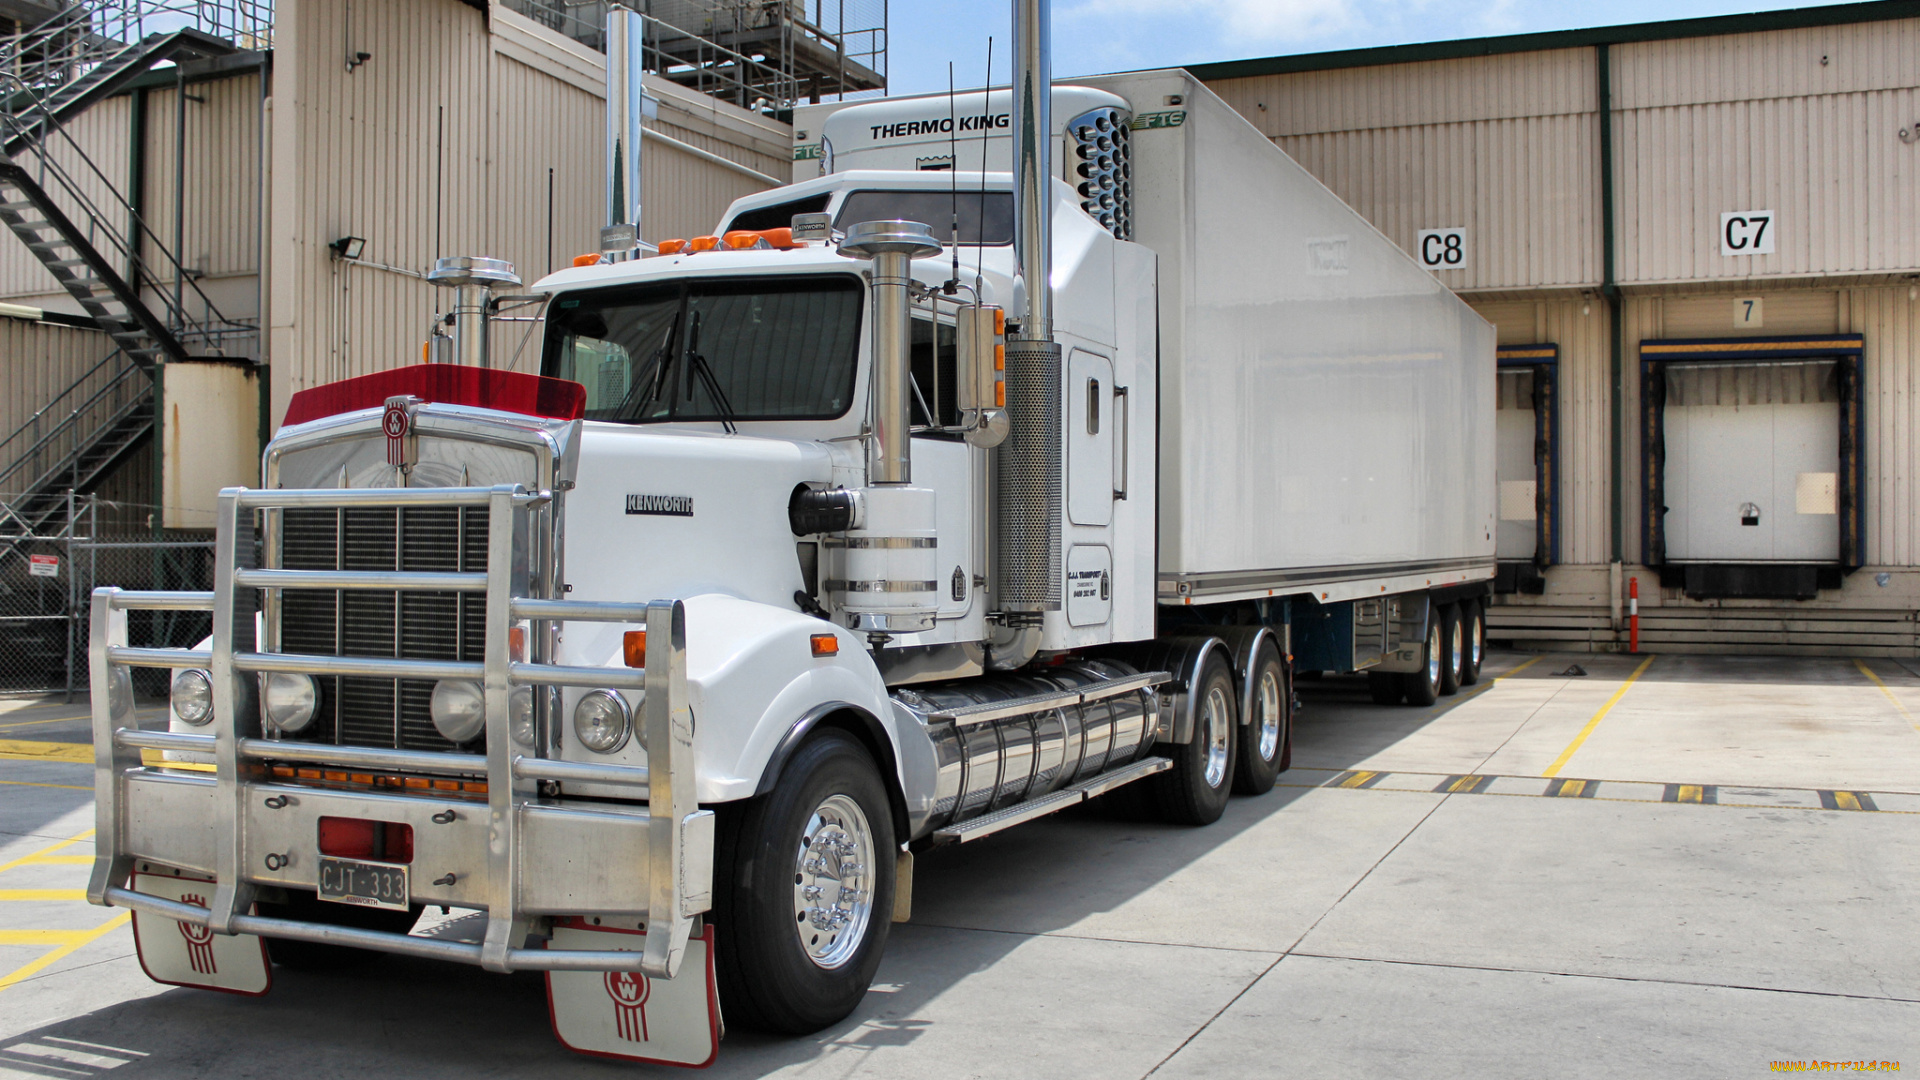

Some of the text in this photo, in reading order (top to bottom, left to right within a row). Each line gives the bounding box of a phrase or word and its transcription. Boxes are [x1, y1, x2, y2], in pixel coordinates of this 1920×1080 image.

[870, 113, 1009, 140] THERMO KING
[1145, 111, 1183, 127] FTE
[793, 145, 821, 160] FTE
[1726, 216, 1769, 250] C7
[1423, 234, 1462, 265] C8
[1743, 300, 1754, 322] 7
[626, 494, 693, 513] KENWORTH
[346, 896, 378, 906] KENWORTH
